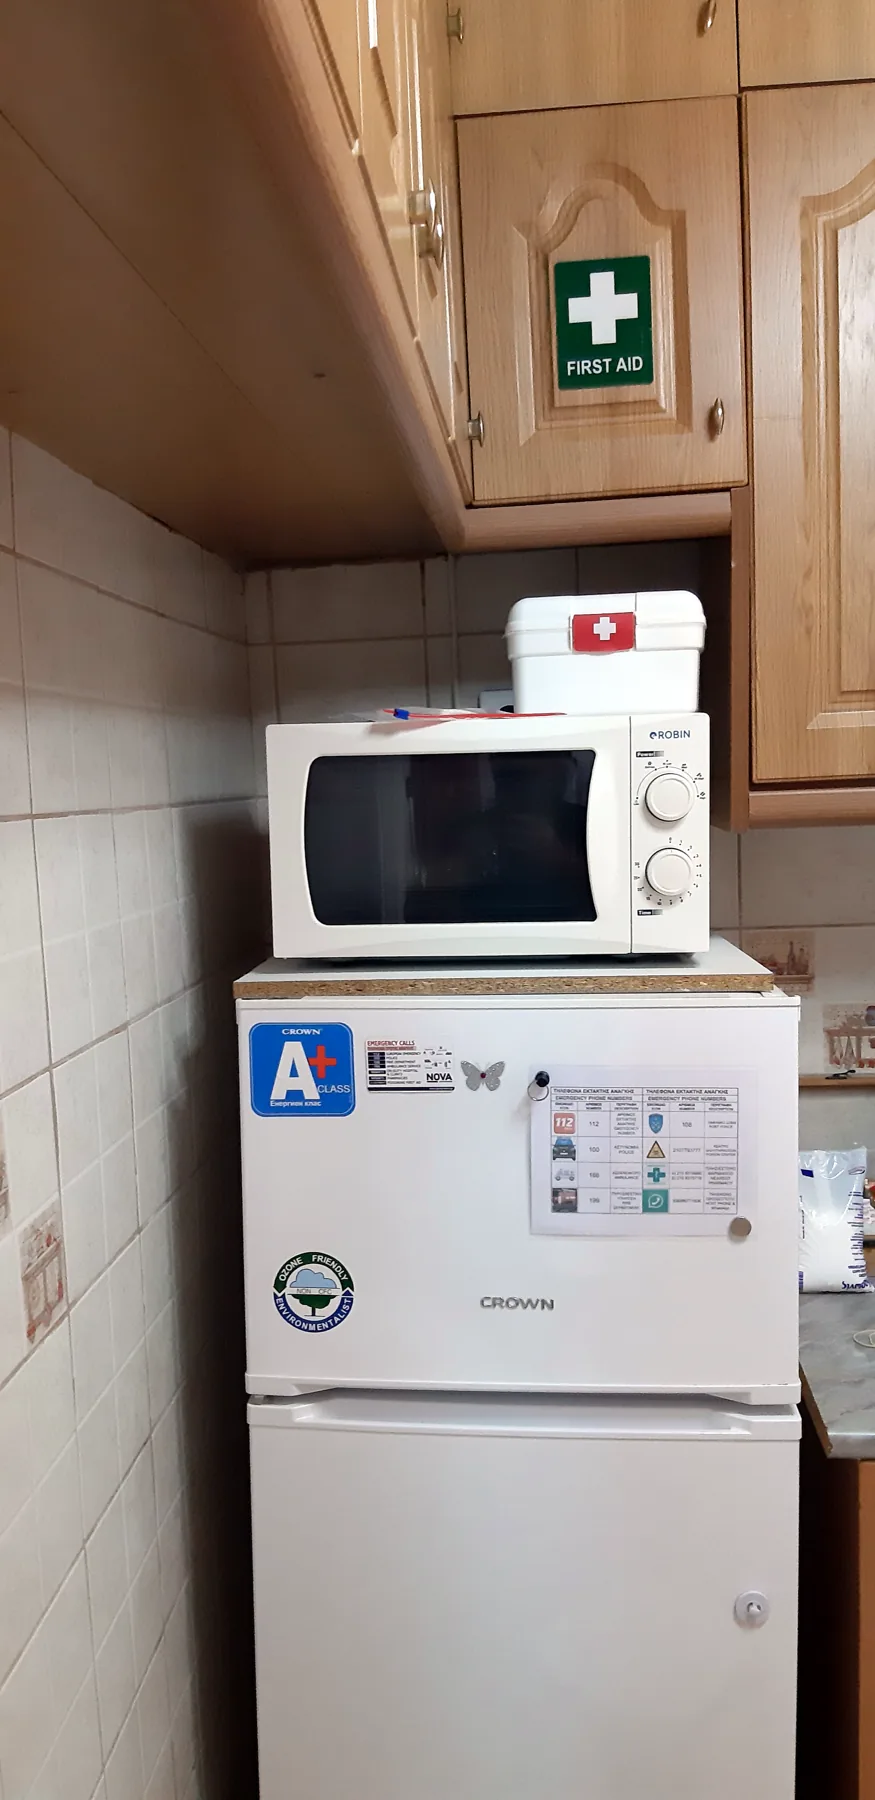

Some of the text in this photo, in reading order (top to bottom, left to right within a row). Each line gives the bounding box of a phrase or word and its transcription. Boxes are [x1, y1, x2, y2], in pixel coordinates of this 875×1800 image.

[567, 356, 643, 376] FIRST AID
[658, 730, 691, 739] ROBIN
[426, 1073, 453, 1081] NOVA
[317, 1085, 351, 1094] CLASS
[555, 1117, 574, 1127] 112
[278, 1254, 349, 1282] OZONE FRIENDLY
[480, 1296, 554, 1311] CROWN
[275, 1297, 352, 1332] ENVIRONMENTALIST
